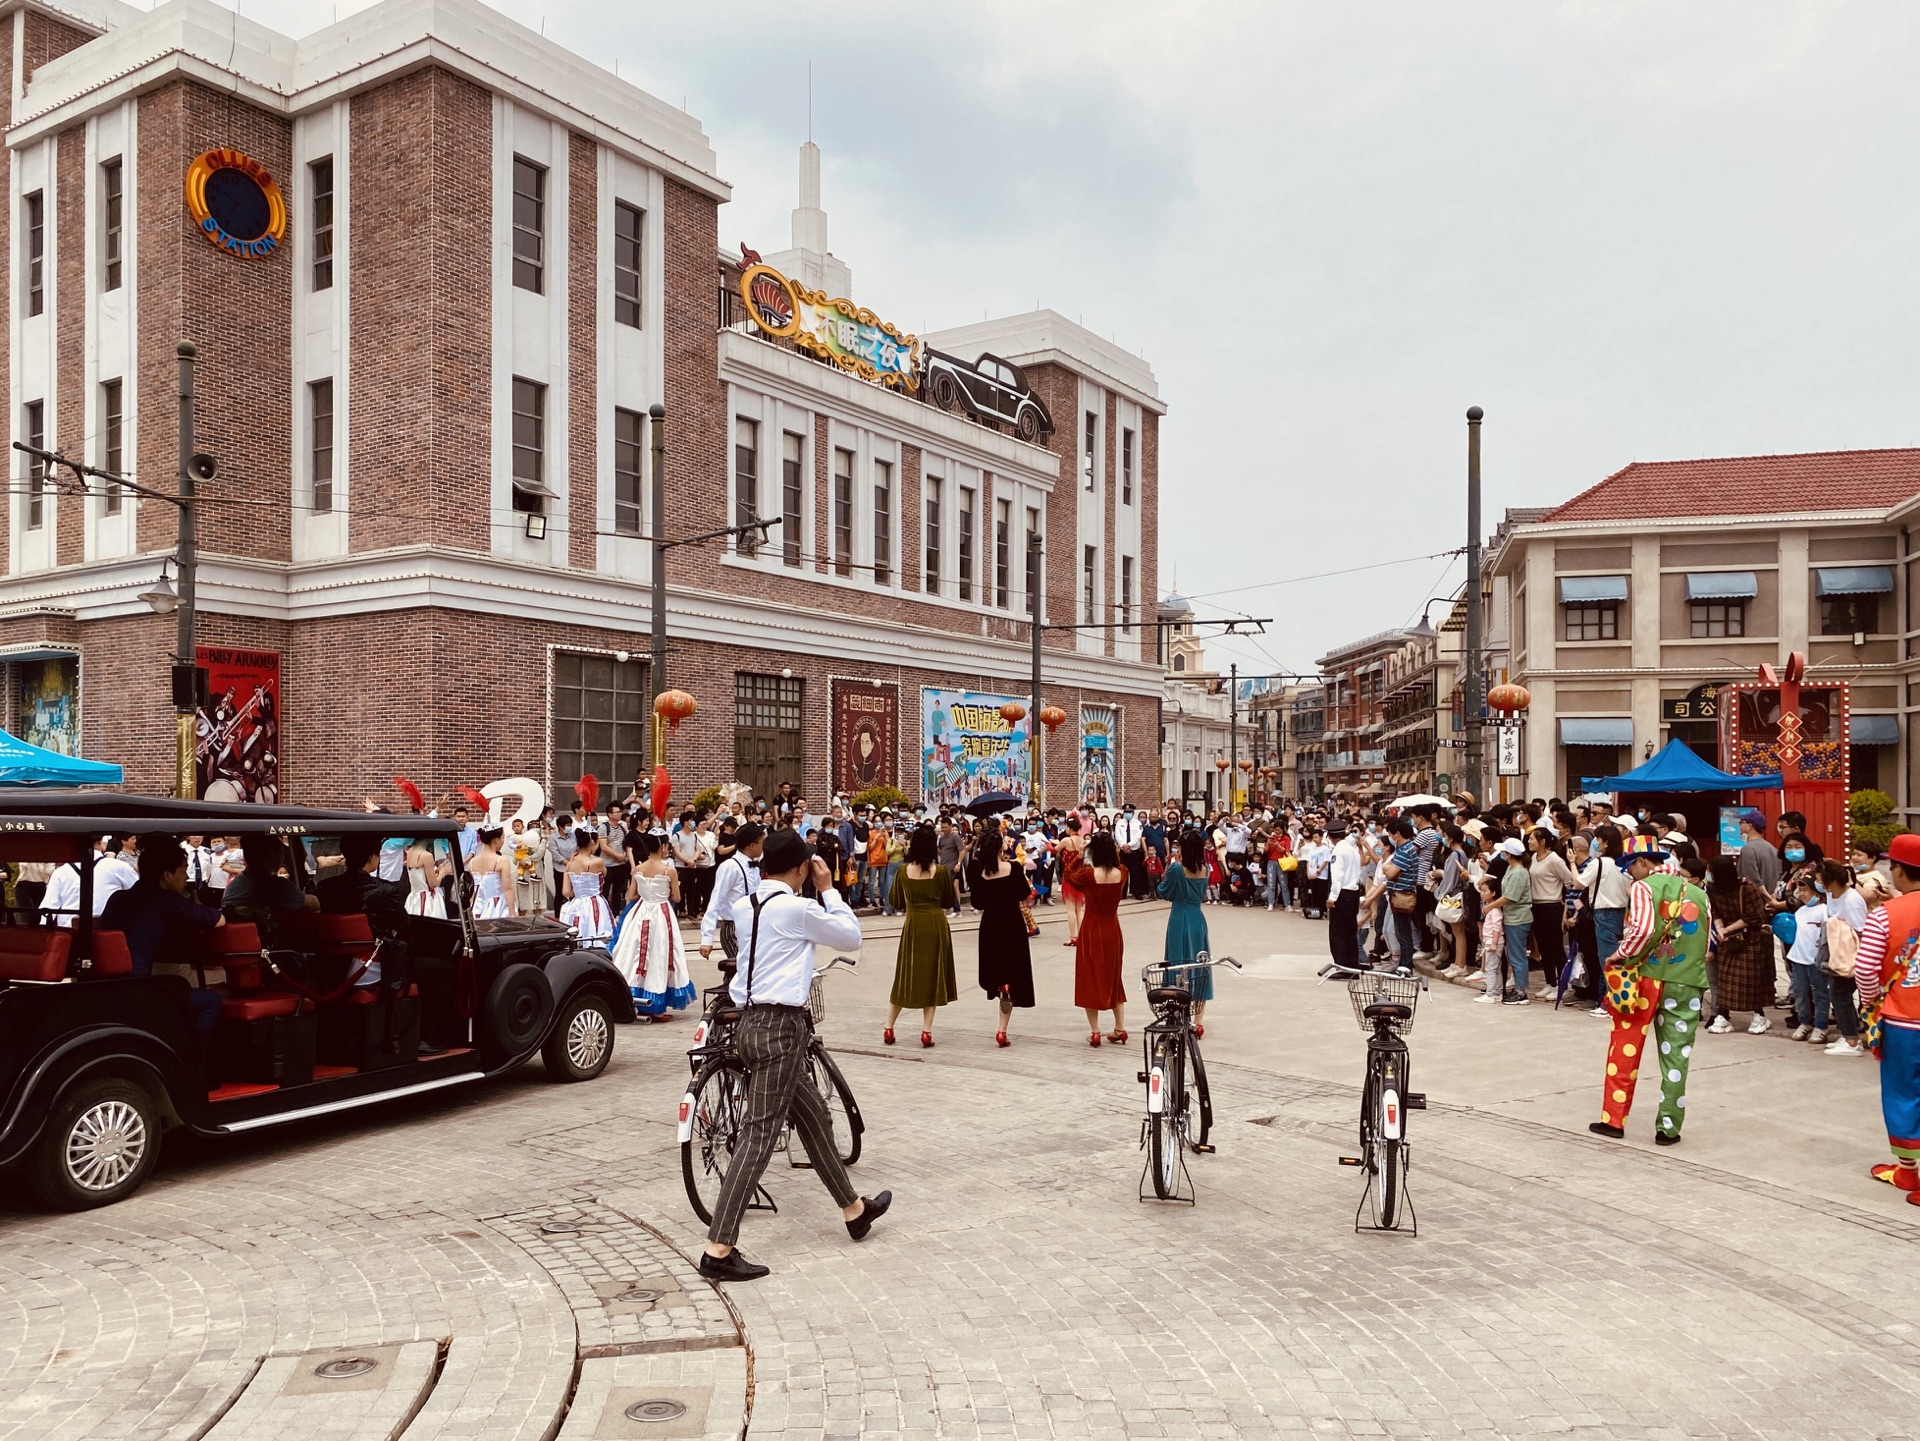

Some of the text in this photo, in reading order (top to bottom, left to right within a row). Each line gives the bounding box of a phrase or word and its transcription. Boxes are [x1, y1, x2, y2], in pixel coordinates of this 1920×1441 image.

[202, 217, 277, 256] STATION
[816, 311, 899, 372] 不眠之夜
[209, 649, 233, 665] BILLY
[235, 653, 278, 672] ARNOLD
[950, 702, 1016, 733] 中国海影
[960, 733, 1012, 758] 奔跑嘉年华
